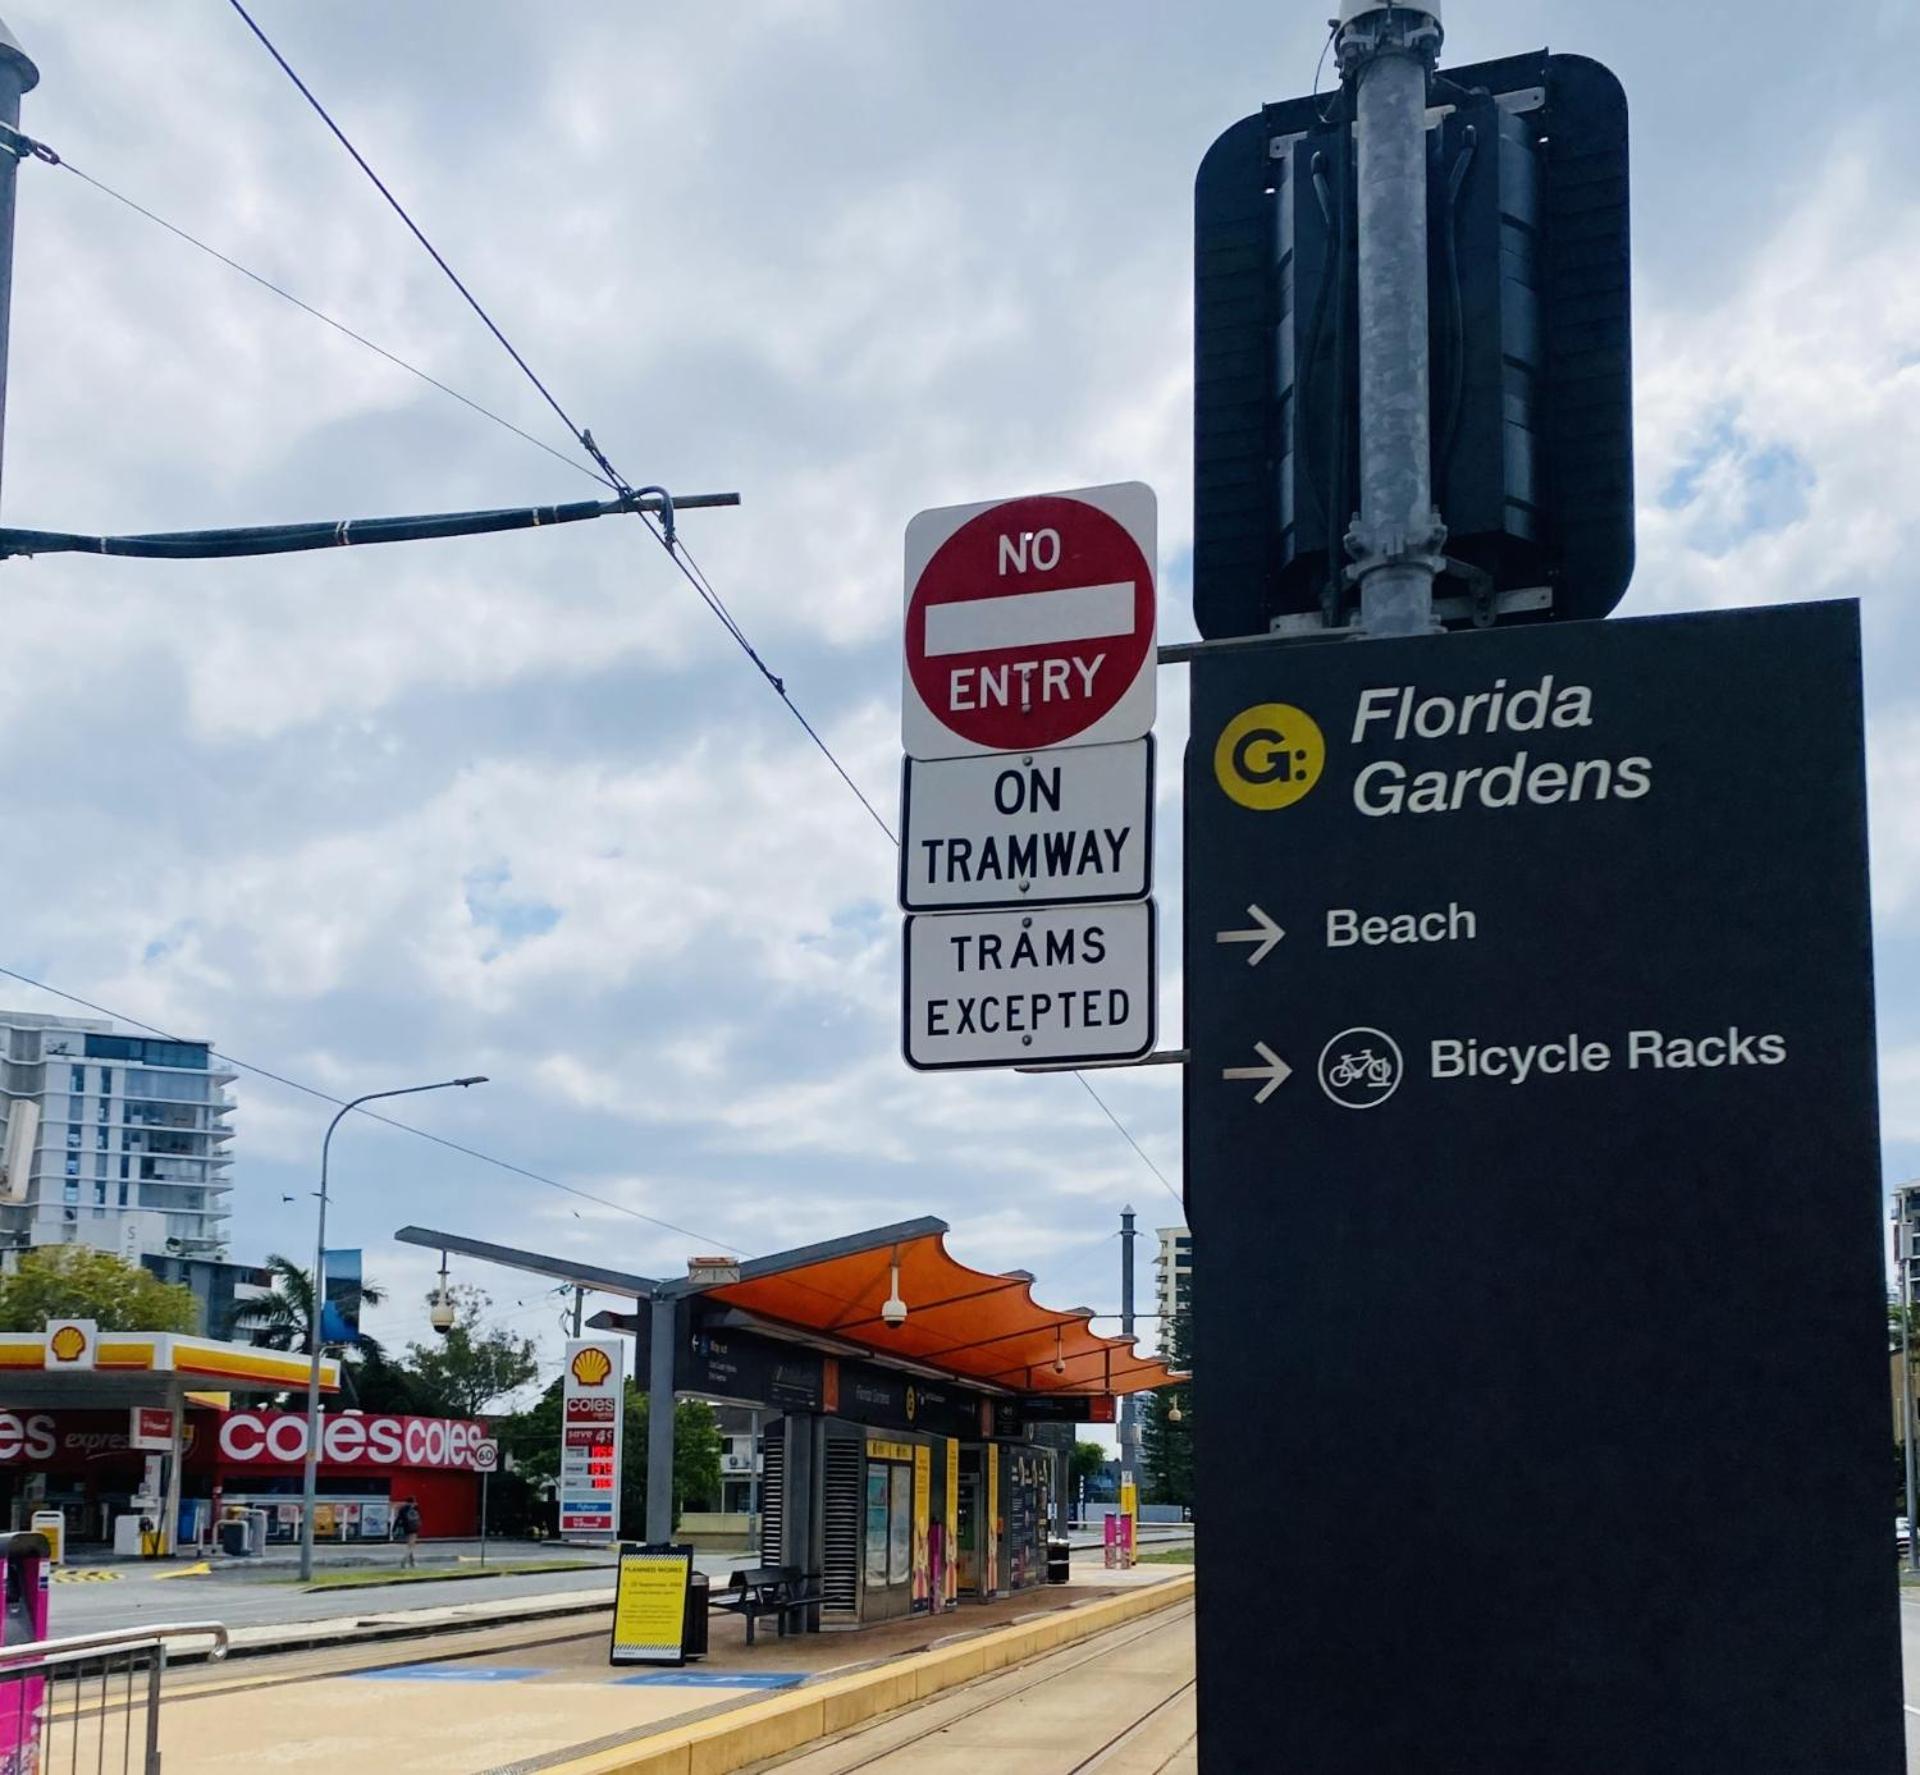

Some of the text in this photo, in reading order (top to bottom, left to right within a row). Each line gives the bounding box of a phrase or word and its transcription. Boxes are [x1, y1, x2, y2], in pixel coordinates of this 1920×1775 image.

[998, 528, 1061, 576] NO
[950, 653, 1106, 711] ENTRY
[1350, 674, 1594, 744] Florida
[994, 766, 1062, 815] ON
[1352, 750, 1653, 817] Gardens
[921, 826, 1131, 884] TRAMWAY
[950, 926, 1106, 972] TRAMS
[1326, 902, 1477, 948] Beach
[927, 988, 1130, 1036] EXCEPTED
[1430, 1026, 1787, 1084] Bicycle Racks
[568, 1397, 614, 1412] coles
[64, 1431, 130, 1452] expres
[219, 1413, 402, 1464] coles
[405, 1419, 482, 1466] coles
[479, 1450, 494, 1461] 60
